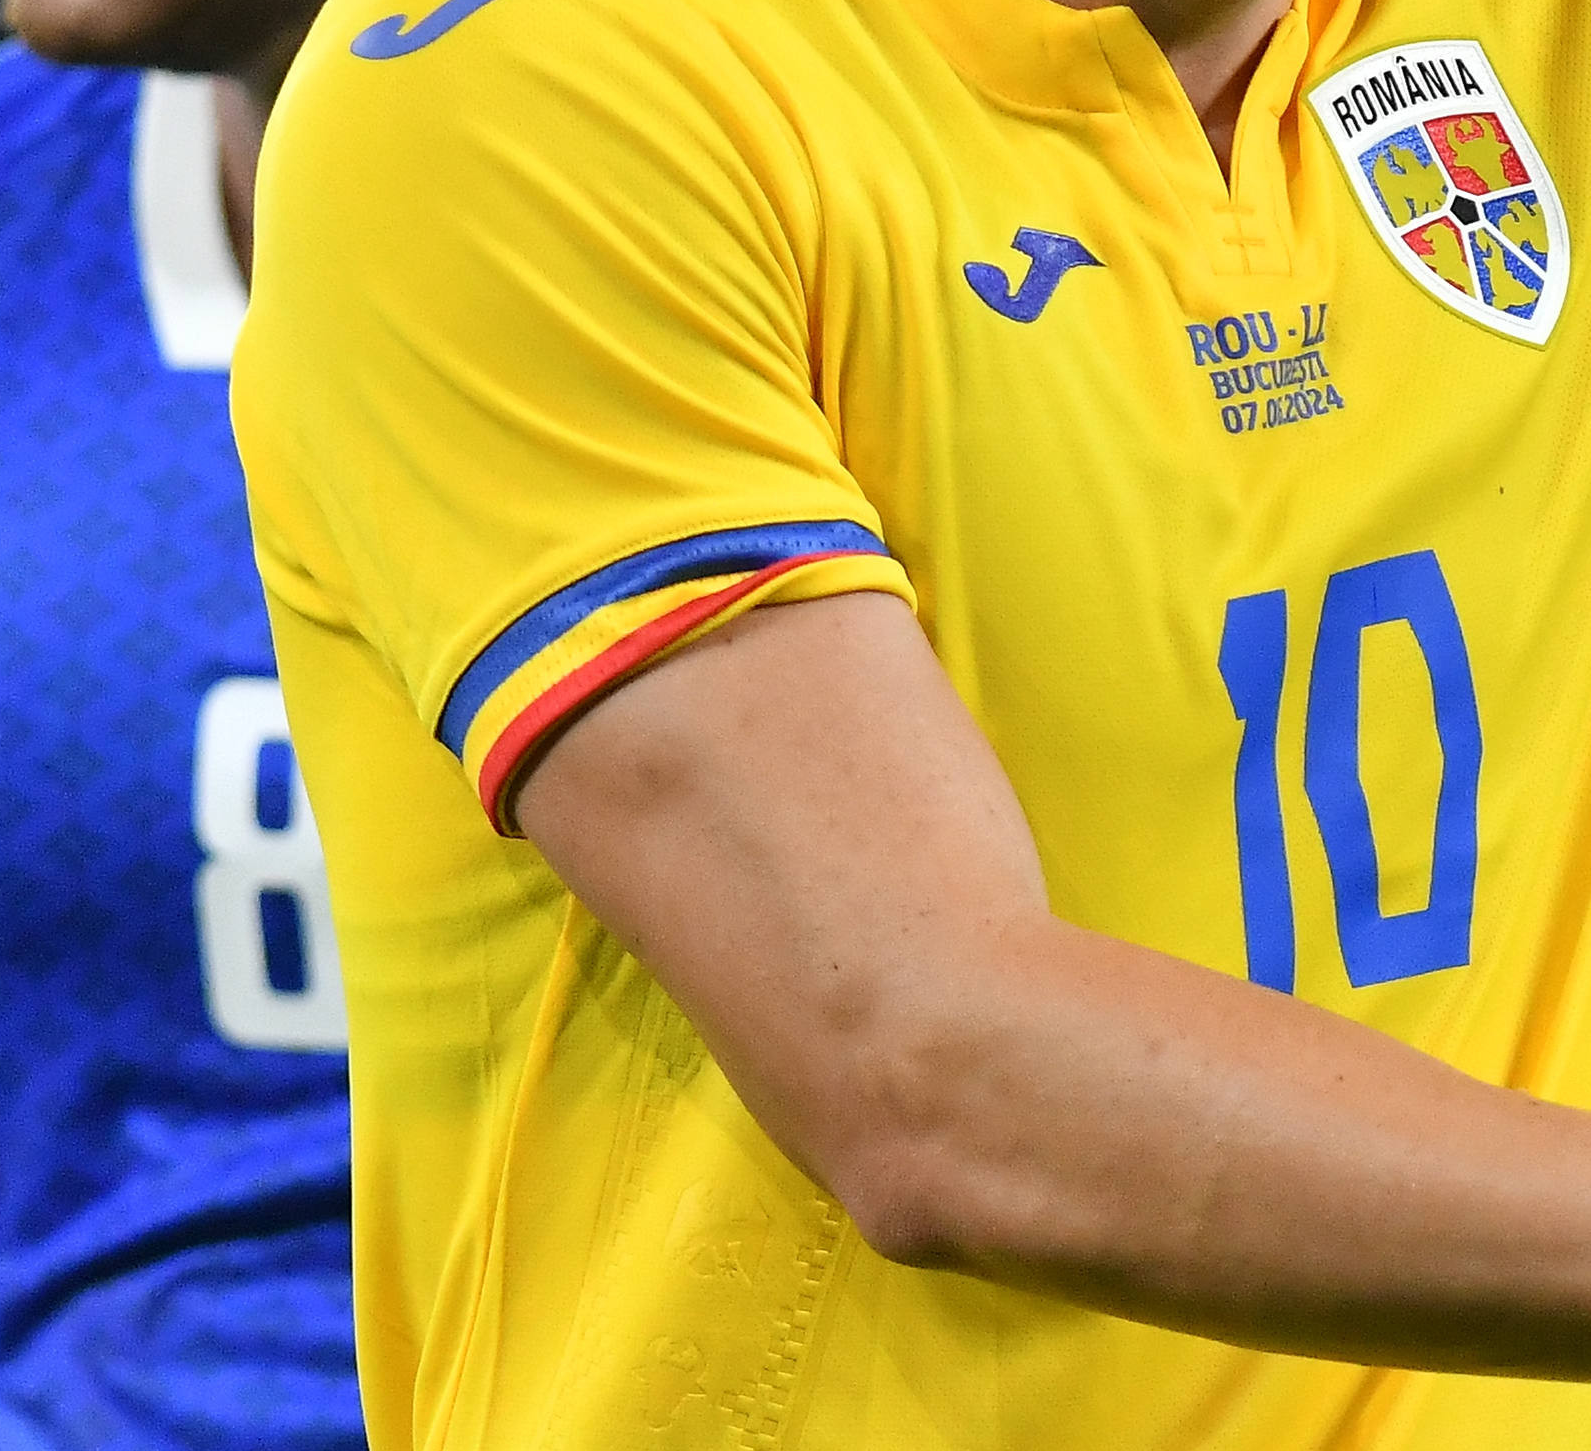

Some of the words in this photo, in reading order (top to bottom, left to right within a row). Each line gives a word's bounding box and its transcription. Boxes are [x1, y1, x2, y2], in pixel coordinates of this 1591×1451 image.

[1332, 56, 1484, 140] ROMÂNIA
[1185, 311, 1278, 366] ROU
[192, 674, 350, 1054] 8
[1217, 549, 1484, 996] 10
